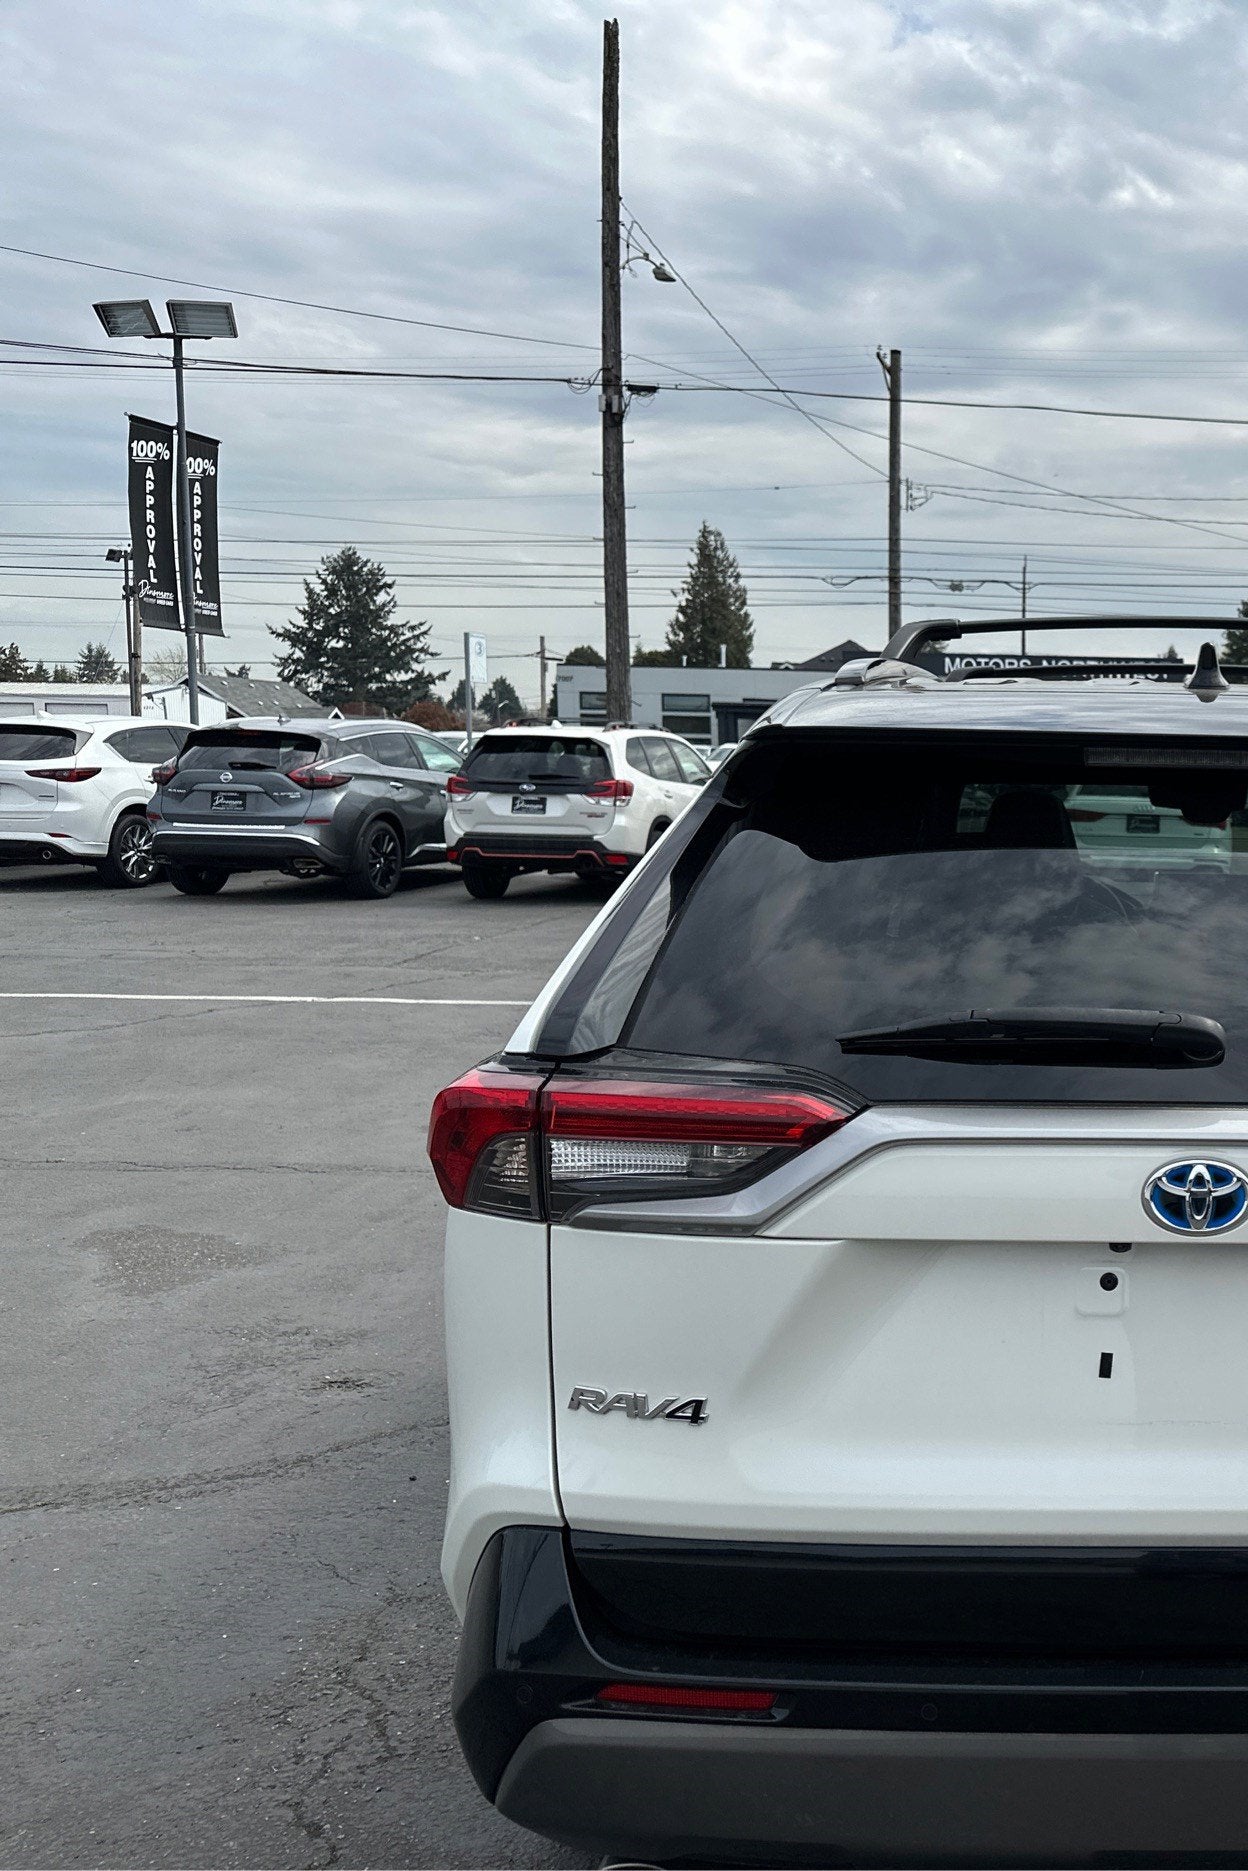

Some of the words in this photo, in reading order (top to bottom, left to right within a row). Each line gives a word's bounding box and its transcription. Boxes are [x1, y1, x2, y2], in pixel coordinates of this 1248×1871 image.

[131, 440, 170, 460] 100%
[186, 456, 216, 476] 00%
[145, 465, 158, 583] APPROVAL
[193, 481, 203, 594] APPROVAL
[944, 657, 1031, 674] MOTORS
[568, 1385, 709, 1426] RAV4
